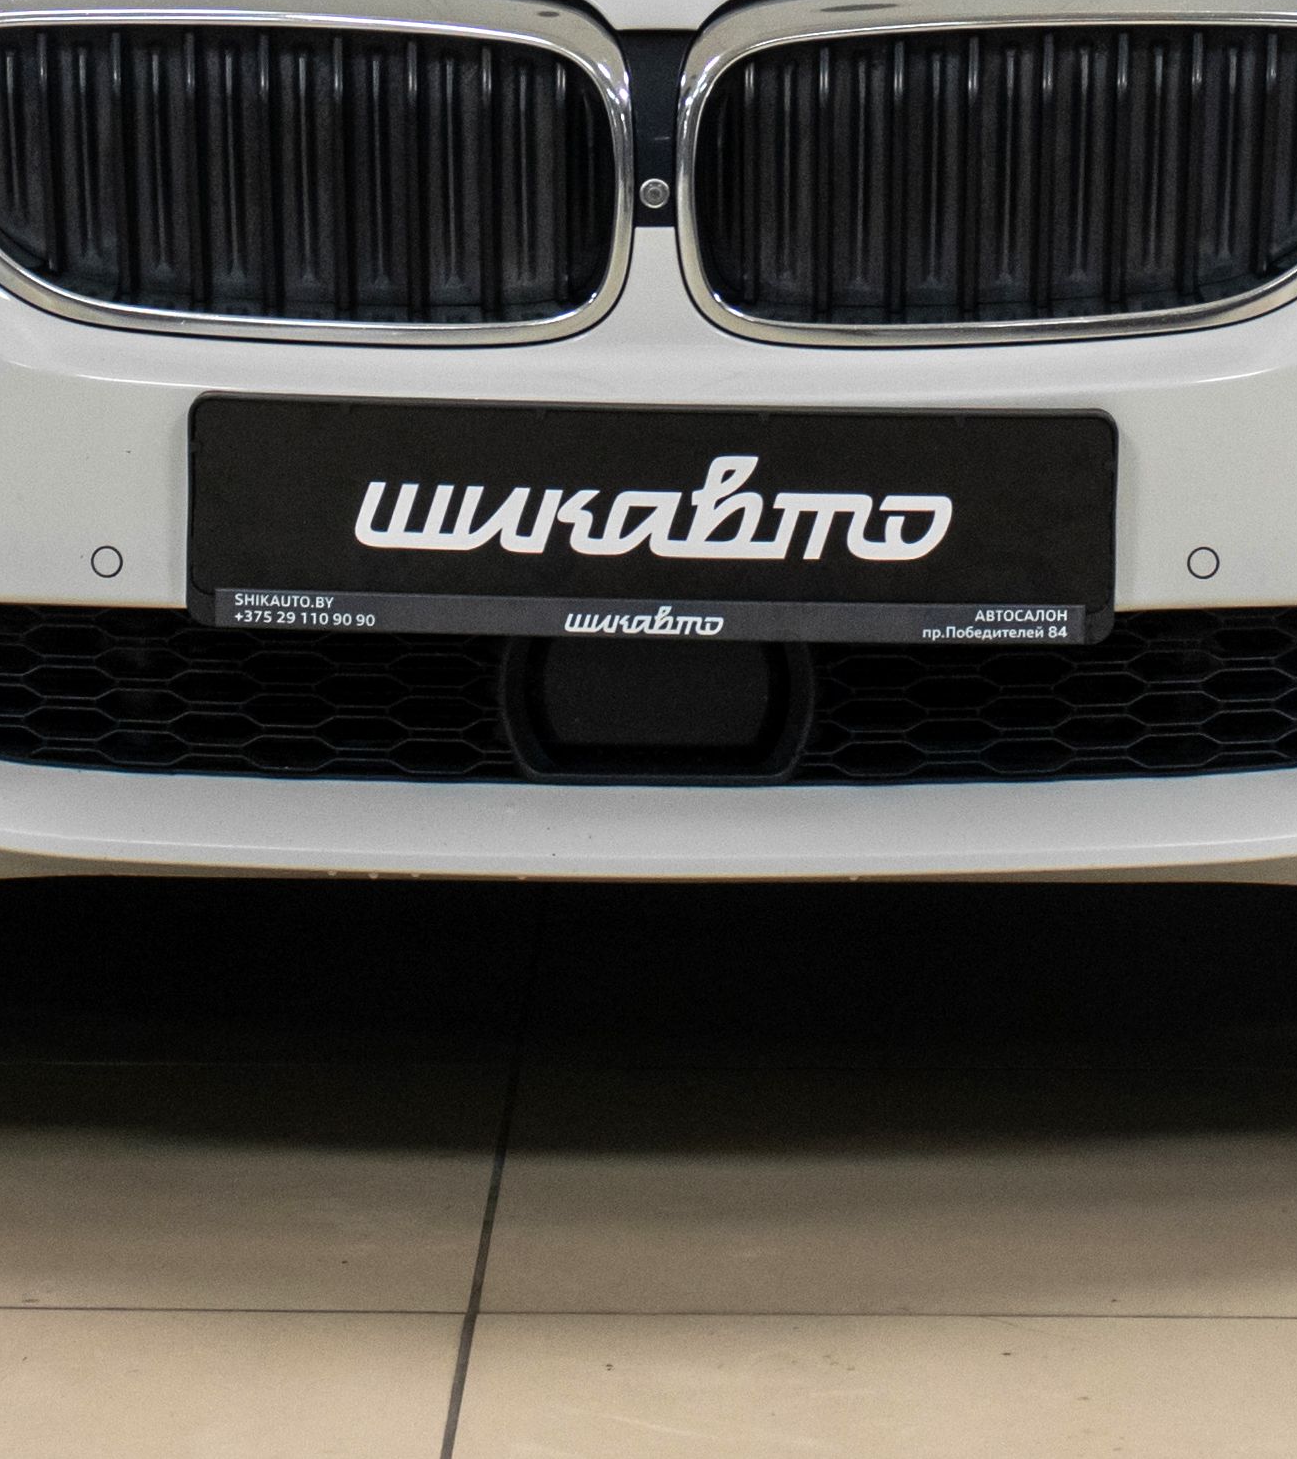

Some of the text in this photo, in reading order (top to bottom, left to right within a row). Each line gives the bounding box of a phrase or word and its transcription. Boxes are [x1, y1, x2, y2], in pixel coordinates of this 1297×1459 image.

[354, 455, 953, 561] шикавто
[234, 592, 335, 609] SHIKAUTO.BY
[234, 609, 376, 627] +375 29 110 90 90
[564, 605, 725, 636] шикавто
[974, 609, 1068, 622] АВТОСАЛОН
[922, 625, 1068, 642] пр.Победителей 84
